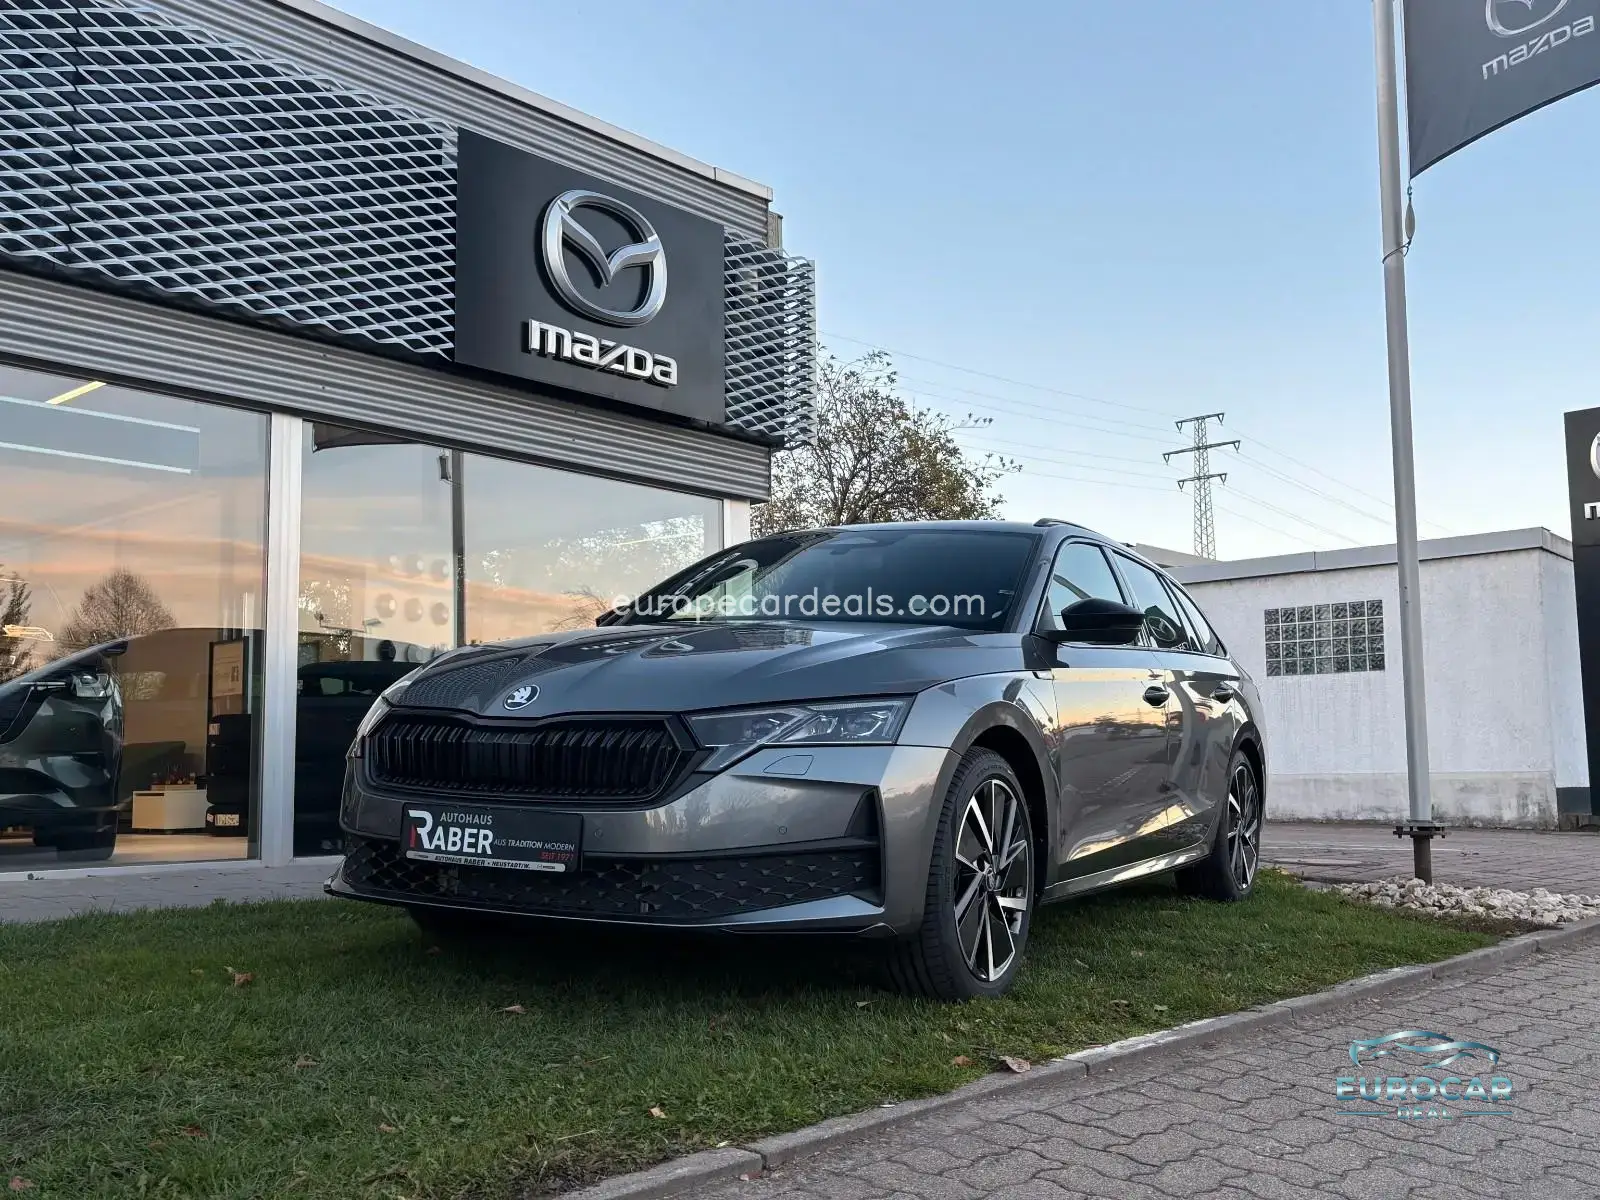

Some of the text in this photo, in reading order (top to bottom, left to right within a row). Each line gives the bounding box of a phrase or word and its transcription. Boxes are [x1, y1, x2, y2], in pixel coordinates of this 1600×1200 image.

[1482, 15, 1595, 80] mazda
[528, 318, 678, 386] mazda
[408, 810, 493, 854] RABER
[440, 812, 493, 825] AUTOHAUS
[494, 838, 575, 851] AUS TRADITION MODERN
[434, 855, 462, 864] AUTOHAUS
[463, 857, 486, 866] RABER
